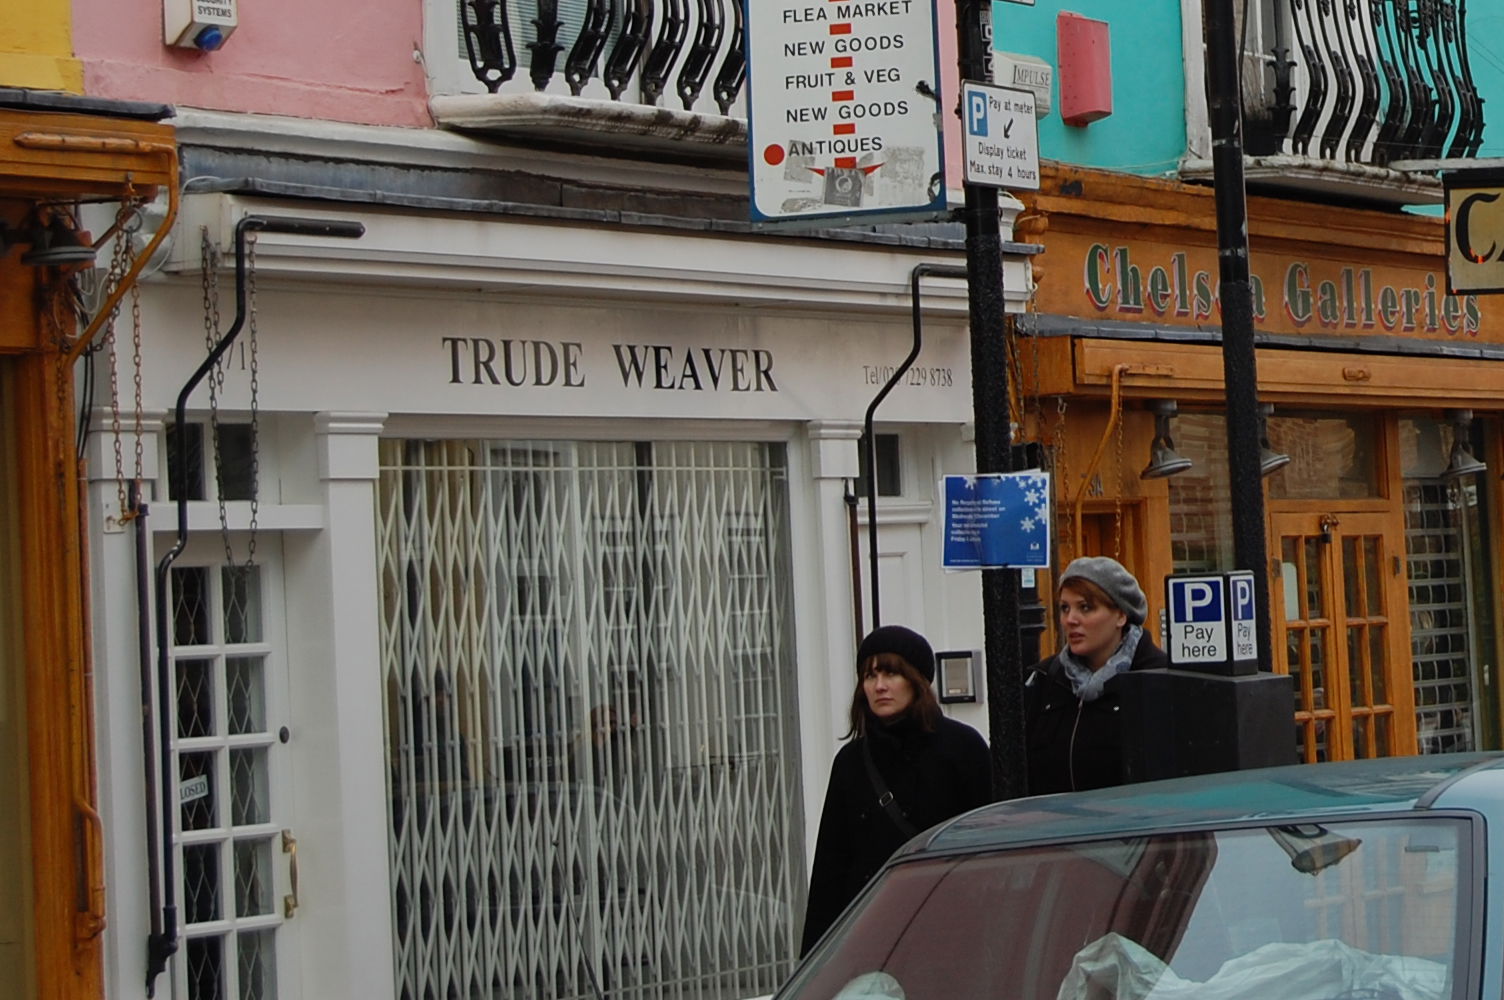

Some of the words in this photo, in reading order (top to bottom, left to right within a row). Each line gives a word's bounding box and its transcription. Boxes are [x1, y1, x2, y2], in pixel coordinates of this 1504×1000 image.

[197, 5, 232, 18] SYSTEMS
[783, 7, 827, 24] FLEA
[837, 0, 912, 19] MARKET
[784, 41, 825, 57] NEW
[835, 35, 904, 53] GOODS
[785, 73, 836, 90] FRUIT
[844, 71, 856, 86] &
[863, 68, 901, 84] VEG
[1012, 64, 1050, 87] IMPULSE
[786, 107, 828, 123] NEW
[838, 100, 909, 119] GOODS
[972, 95, 985, 132] P
[788, 136, 883, 157] ANTIQUES
[978, 141, 1004, 160] Display
[1006, 146, 1027, 161] ticket
[988, 163, 1003, 179] stay
[1007, 165, 1013, 178] 4
[1017, 165, 1037, 180] hours
[1084, 242, 1266, 323] Chelsa
[1284, 261, 1481, 337] Galleries
[442, 336, 586, 388] TRUDE
[611, 343, 779, 392] WEAVER
[930, 368, 953, 387] 8738
[1184, 582, 1213, 622] P
[1236, 580, 1250, 620] P
[1184, 624, 1214, 643] Pay
[1237, 623, 1251, 641] Pay
[1182, 643, 1217, 658] here
[1237, 643, 1253, 656] here
[180, 781, 206, 800] LOSED
